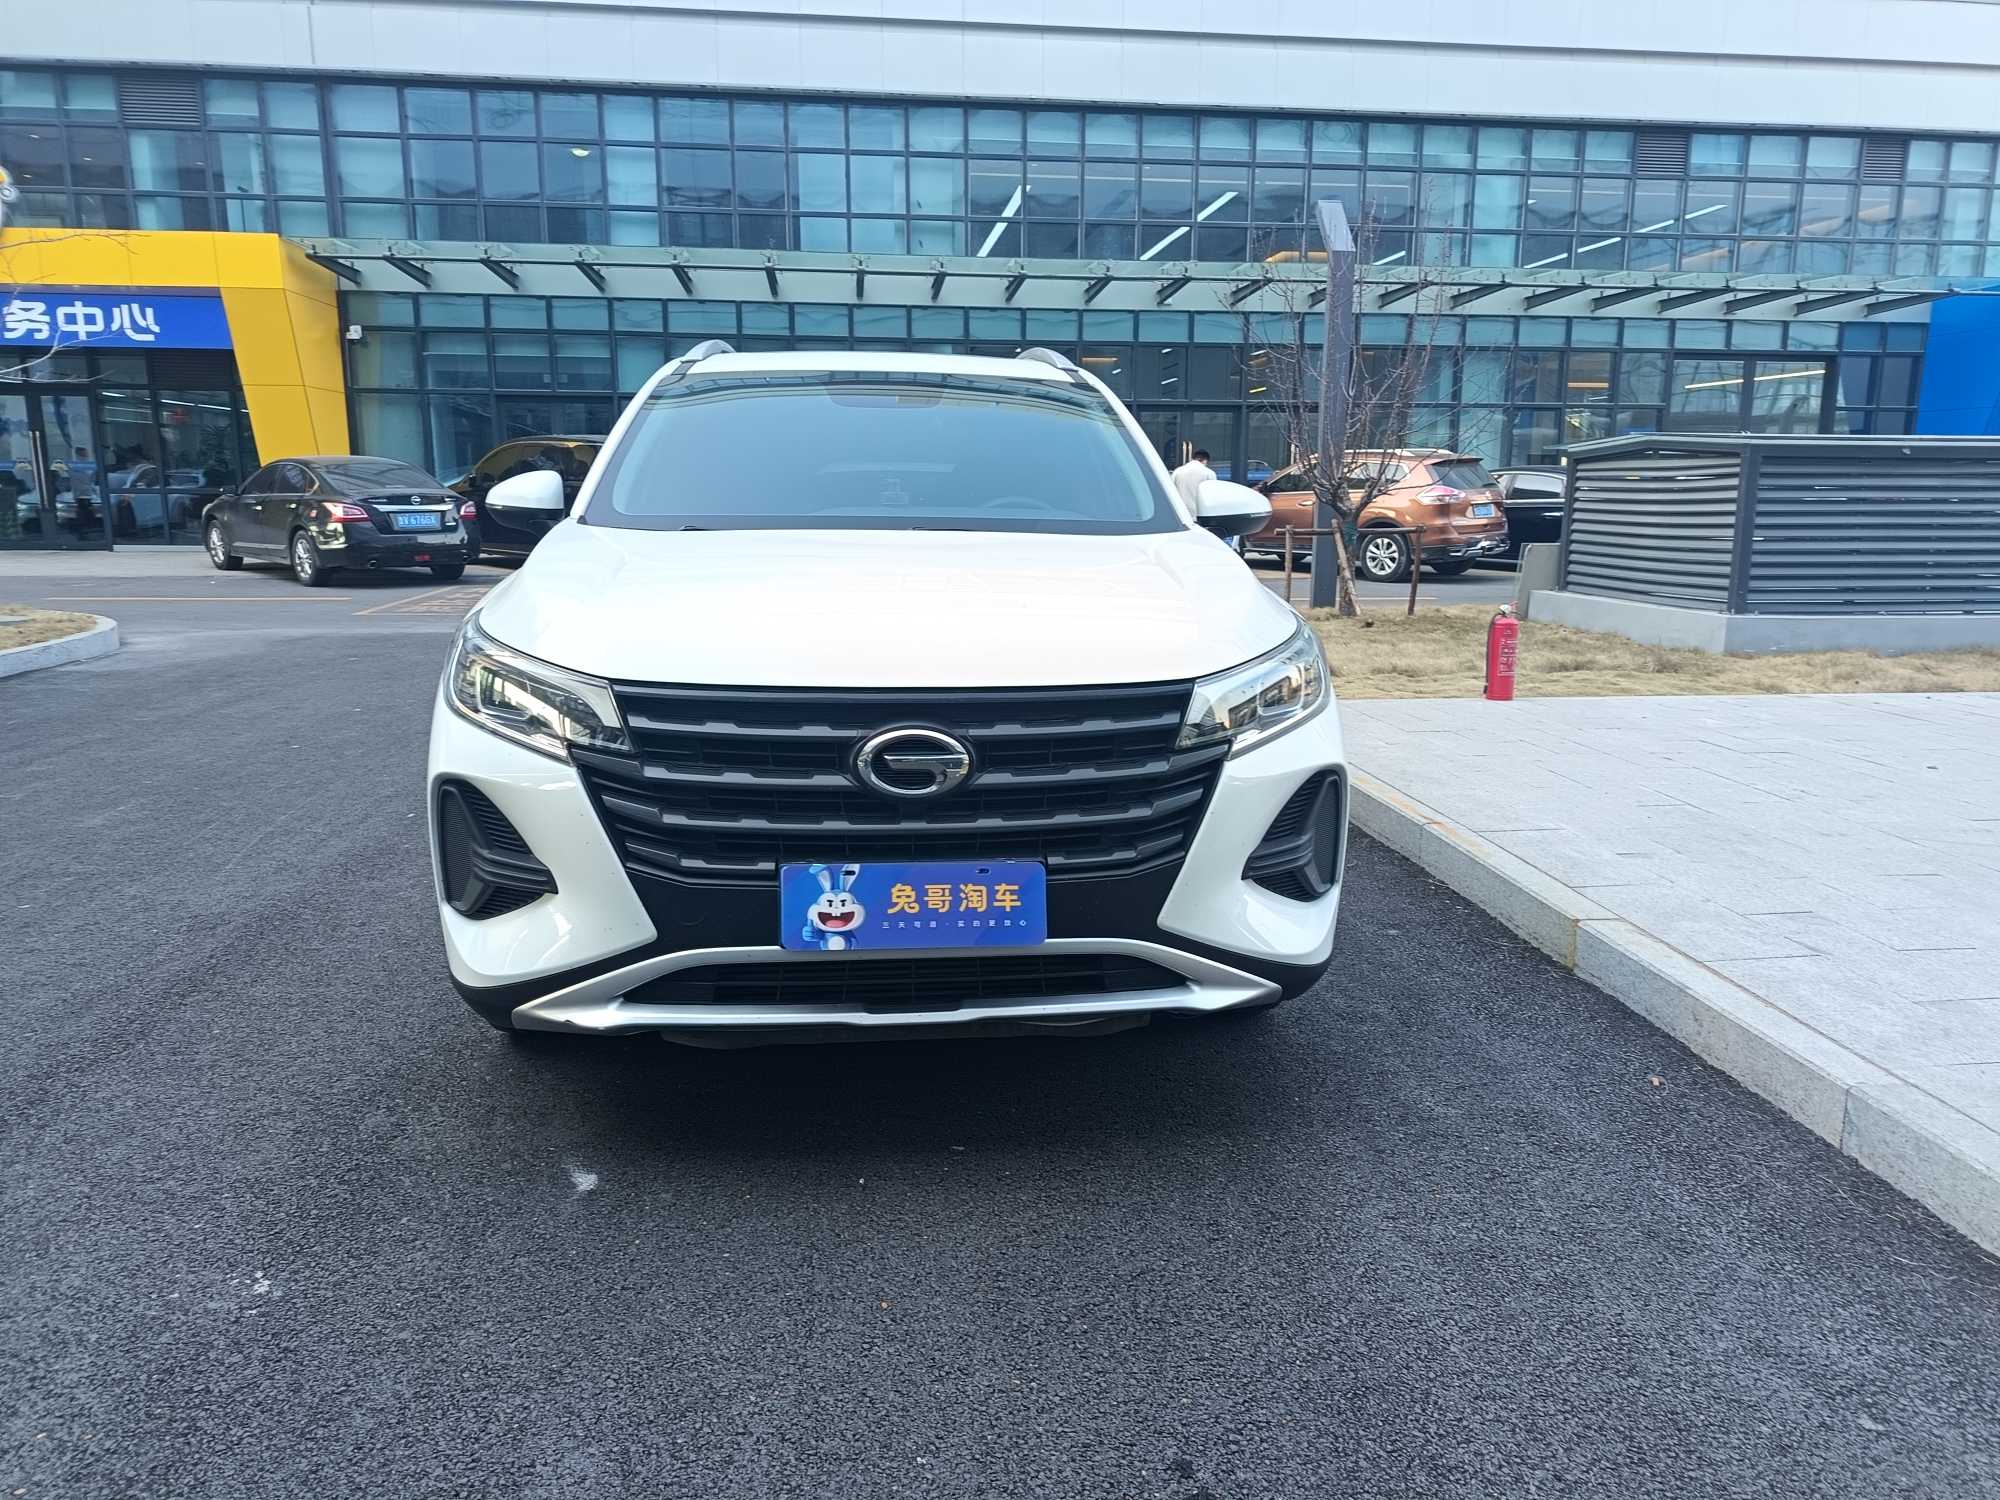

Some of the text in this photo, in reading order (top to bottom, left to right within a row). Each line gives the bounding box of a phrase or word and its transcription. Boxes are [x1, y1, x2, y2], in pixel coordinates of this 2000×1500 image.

[2, 300, 160, 342] 务中心
[887, 883, 1021, 914] 兔哥淘车
